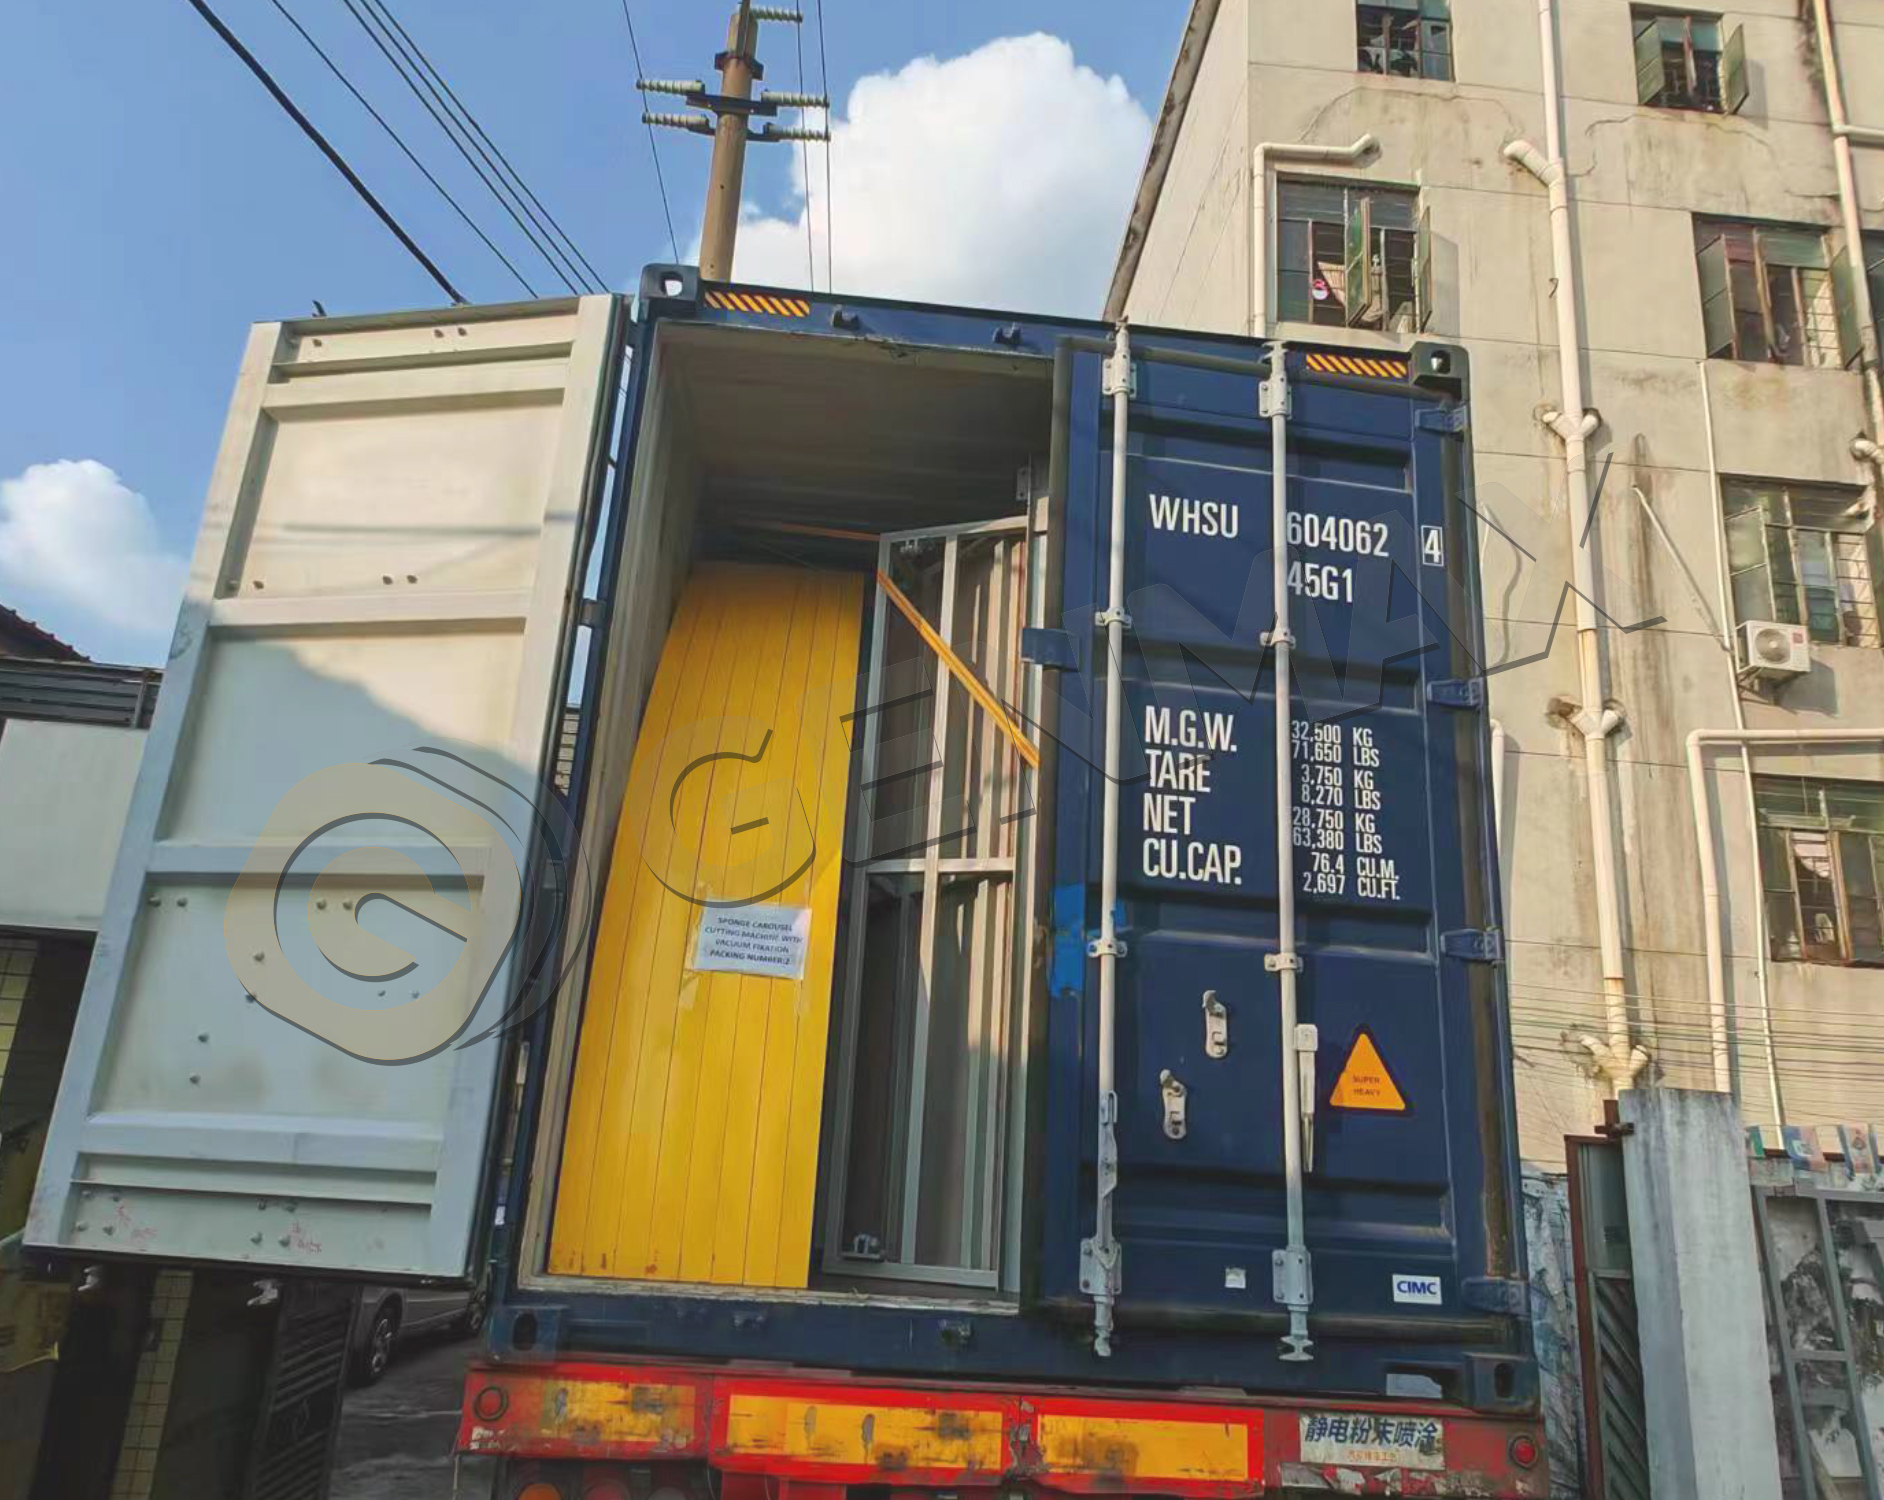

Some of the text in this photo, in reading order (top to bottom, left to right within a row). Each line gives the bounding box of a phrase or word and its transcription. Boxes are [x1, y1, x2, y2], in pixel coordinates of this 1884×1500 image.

[1149, 493, 1442, 563] WHSU 604062 4
[1287, 561, 1353, 603] 45G1
[1145, 705, 1373, 752] M.G.W. 32,500 KG
[1291, 739, 1380, 767] 71,650 LBS
[1145, 748, 1374, 793] TARE 3,750 KG
[1301, 783, 1381, 810] 8,270 LBS
[1143, 792, 1375, 835] NET 28,750 KG
[1293, 827, 1383, 854] 63,380 LBS
[1143, 837, 1399, 885] CU.CAP. 76.4 CU.M.
[1303, 872, 1400, 900] 2,697 CU.FT.
[704, 927, 740, 937] CUTTING
[781, 934, 803, 944] WITH
[718, 916, 792, 932] SPONGE CAROUSEL
[709, 949, 745, 960] PACKING
[716, 938, 751, 949] VACUUM
[1352, 1075, 1380, 1083] SUPER
[1353, 1088, 1381, 1096] HEAVY
[1396, 1280, 1437, 1295] CIMC
[1305, 1417, 1438, 1450] 静电粉末喷涂
